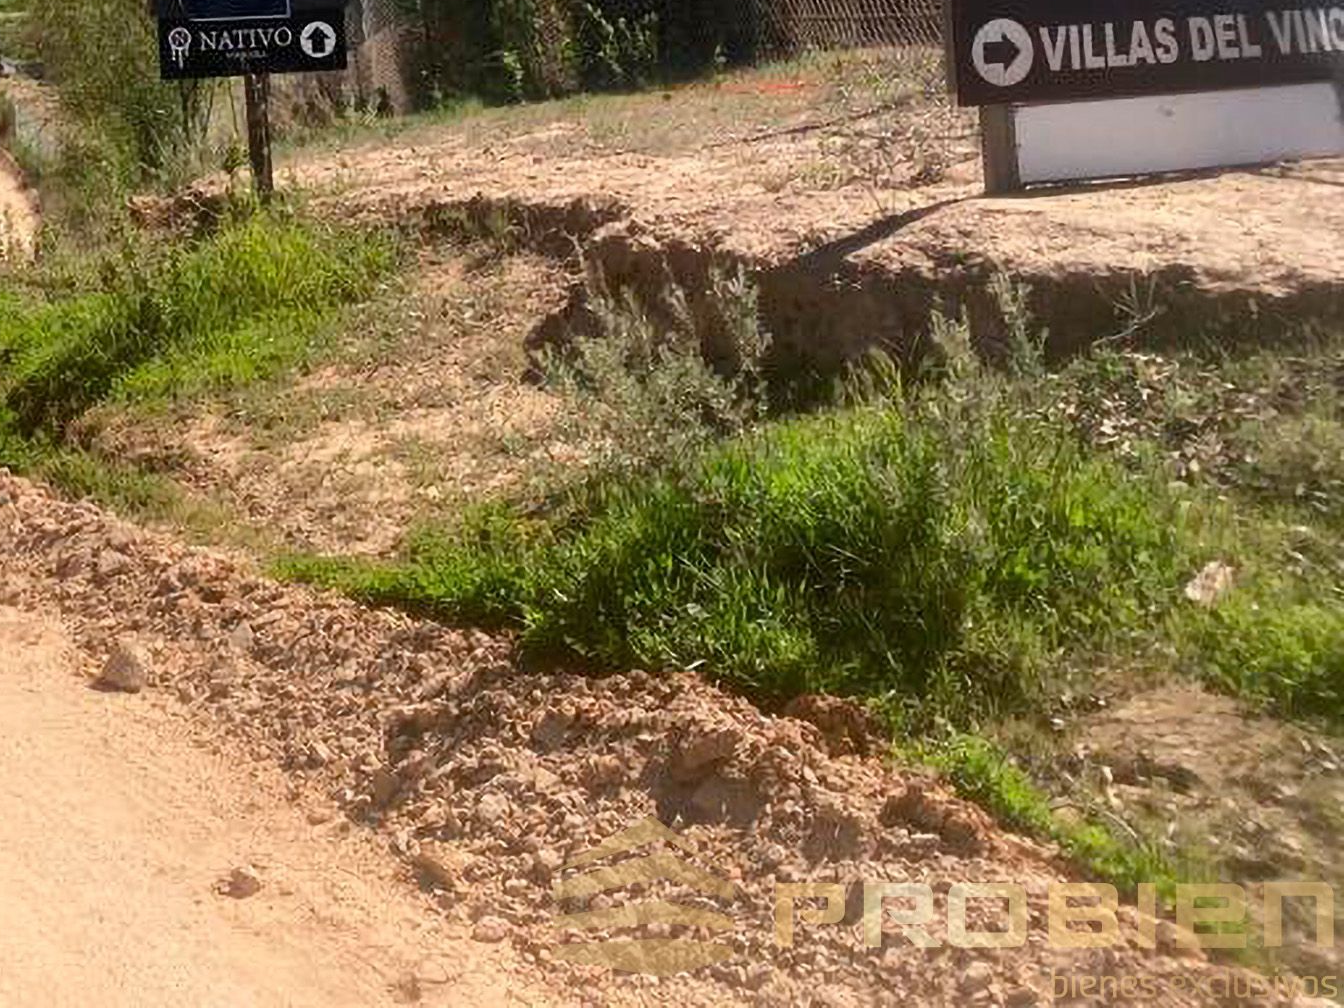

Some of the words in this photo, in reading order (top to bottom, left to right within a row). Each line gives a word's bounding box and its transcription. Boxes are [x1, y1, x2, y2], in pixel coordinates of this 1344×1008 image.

[199, 26, 292, 52] NATIVO
[1039, 18, 1180, 72] VILLAS
[1188, 13, 1262, 62] DEL
